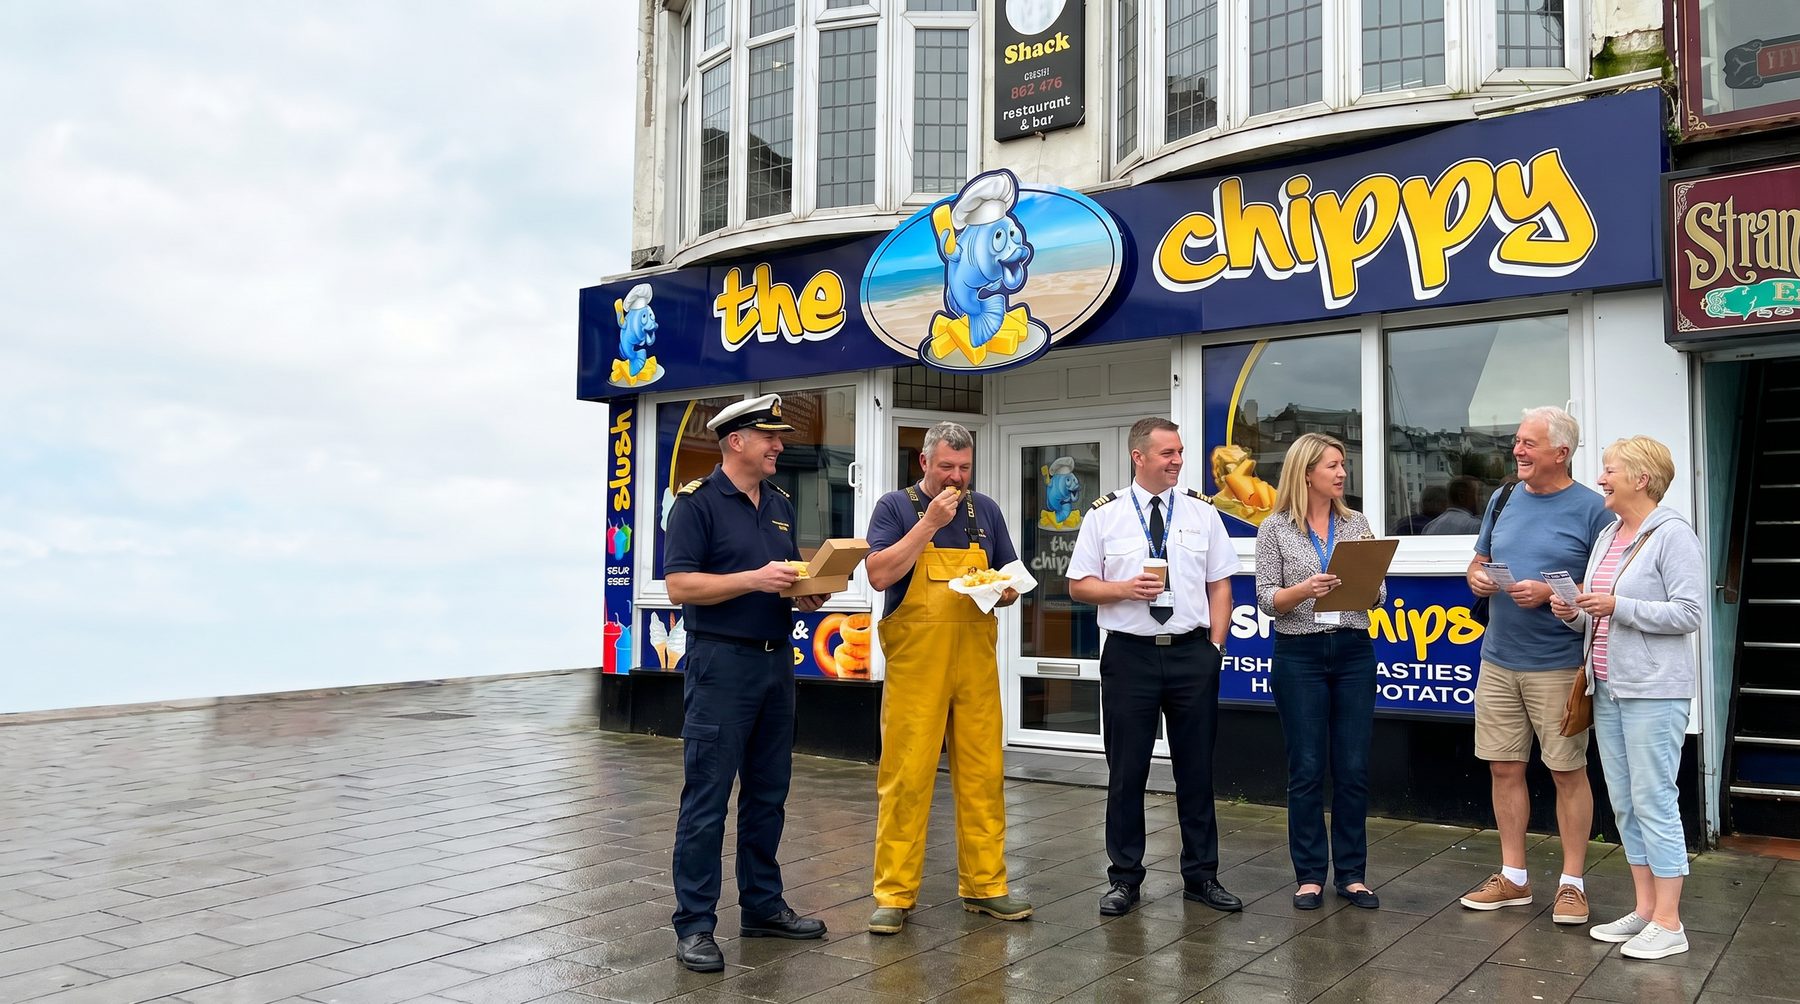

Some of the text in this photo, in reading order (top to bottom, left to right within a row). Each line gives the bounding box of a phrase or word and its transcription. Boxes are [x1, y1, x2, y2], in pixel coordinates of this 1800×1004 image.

[1004, 32, 1070, 65] Shack
[1040, 77, 1063, 93] 476
[1003, 95, 1071, 120] restaurant
[1019, 114, 1054, 131] & bar
[713, 147, 1598, 352] the chippy
[1773, 282, 1800, 301] E
[609, 408, 633, 512] slush
[1030, 551, 1071, 576] chip
[792, 620, 809, 639] &
[1251, 677, 1273, 693] H
